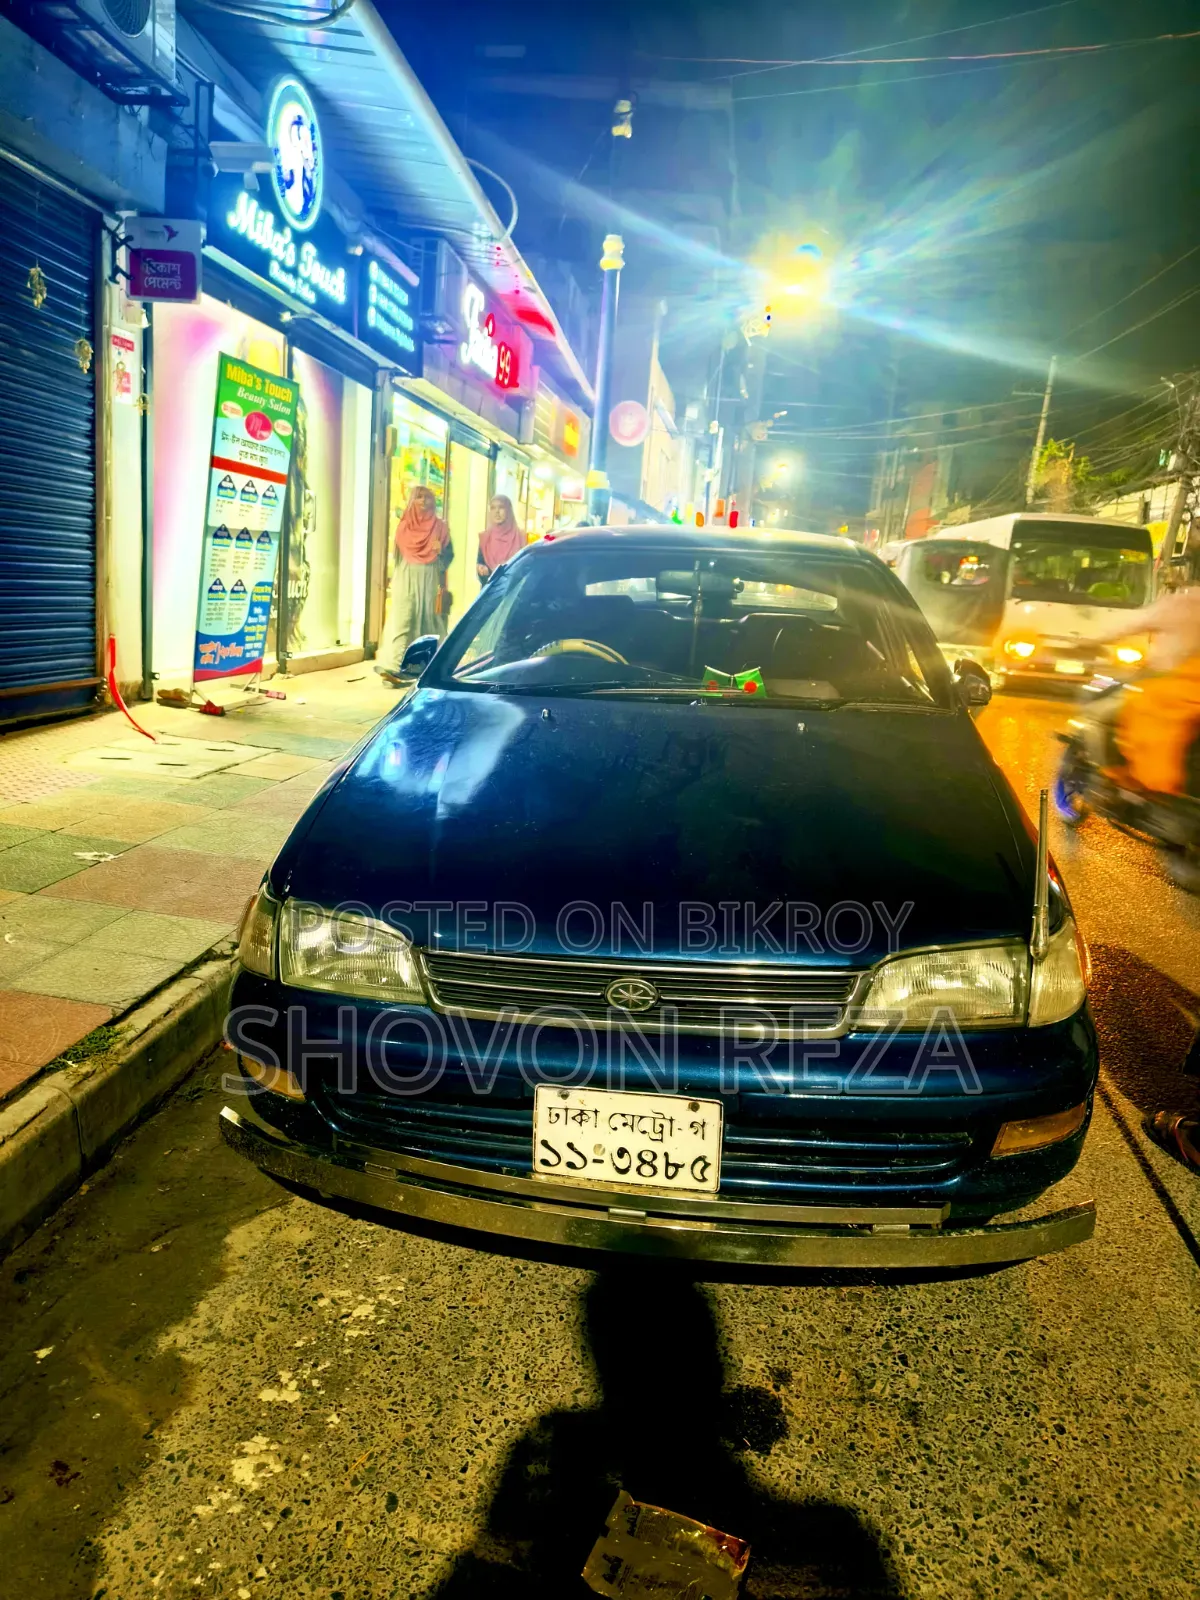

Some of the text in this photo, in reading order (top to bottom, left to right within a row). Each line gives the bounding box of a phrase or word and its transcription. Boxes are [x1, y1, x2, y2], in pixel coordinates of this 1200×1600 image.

[227, 191, 295, 267] Miba's
[298, 241, 346, 304] Touch
[144, 275, 182, 290] পেমেন্ট
[226, 363, 292, 403] Miba's Touch
[237, 387, 291, 415] Beauty Salon
[547, 1106, 600, 1128] ঢাকা
[539, 1139, 712, 1183] ১১-৩৪৮৫
